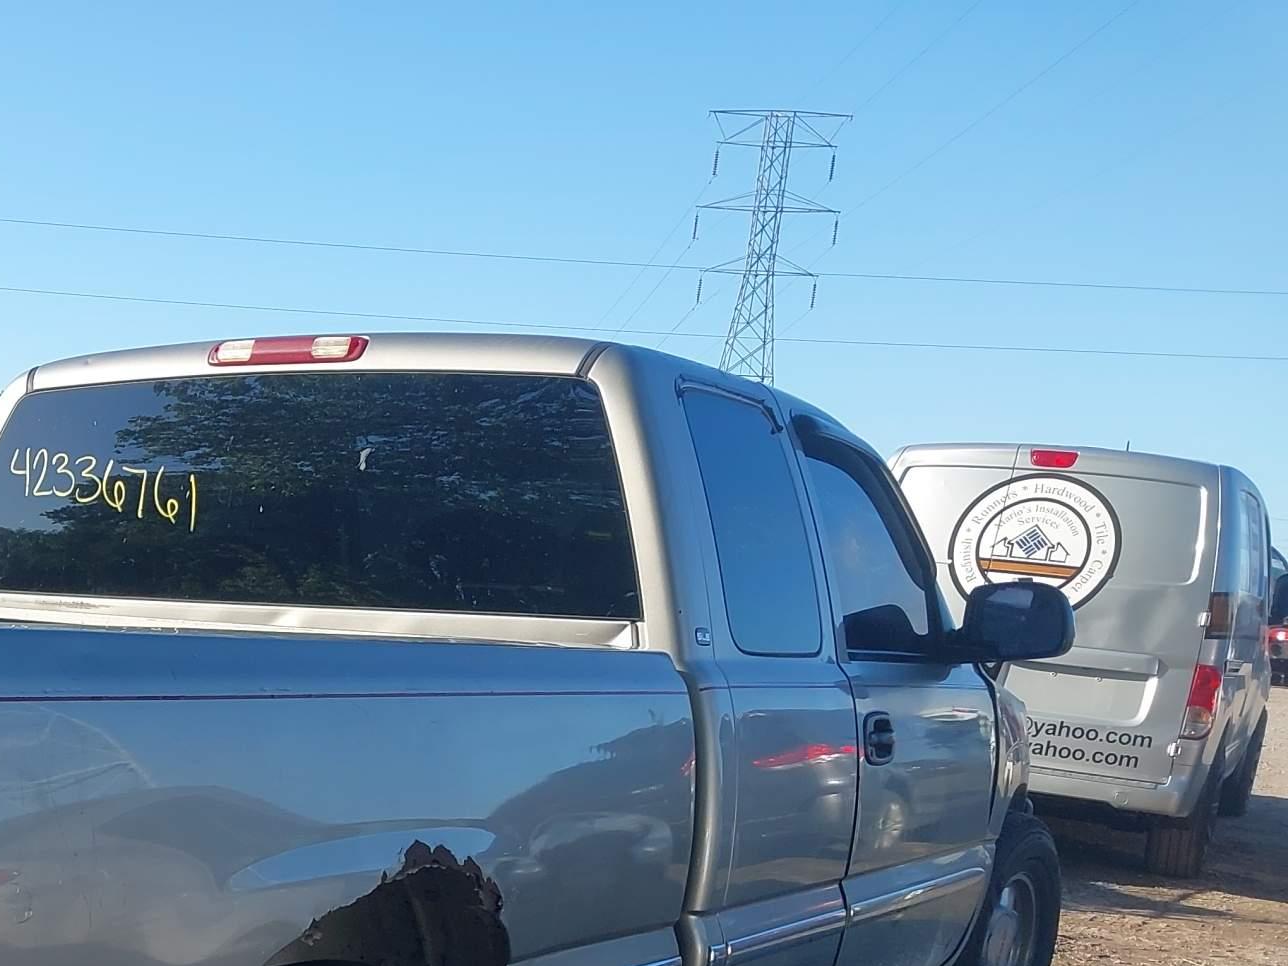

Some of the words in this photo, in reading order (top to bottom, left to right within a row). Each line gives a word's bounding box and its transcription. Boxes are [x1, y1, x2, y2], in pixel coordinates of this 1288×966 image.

[10, 447, 197, 532] 42336761
[1034, 483, 1095, 513] Hardwood
[1017, 515, 1061, 530] Services
[1035, 504, 1080, 537] Installation
[1094, 521, 1109, 545] Tile
[1072, 560, 1104, 592] Carpet
